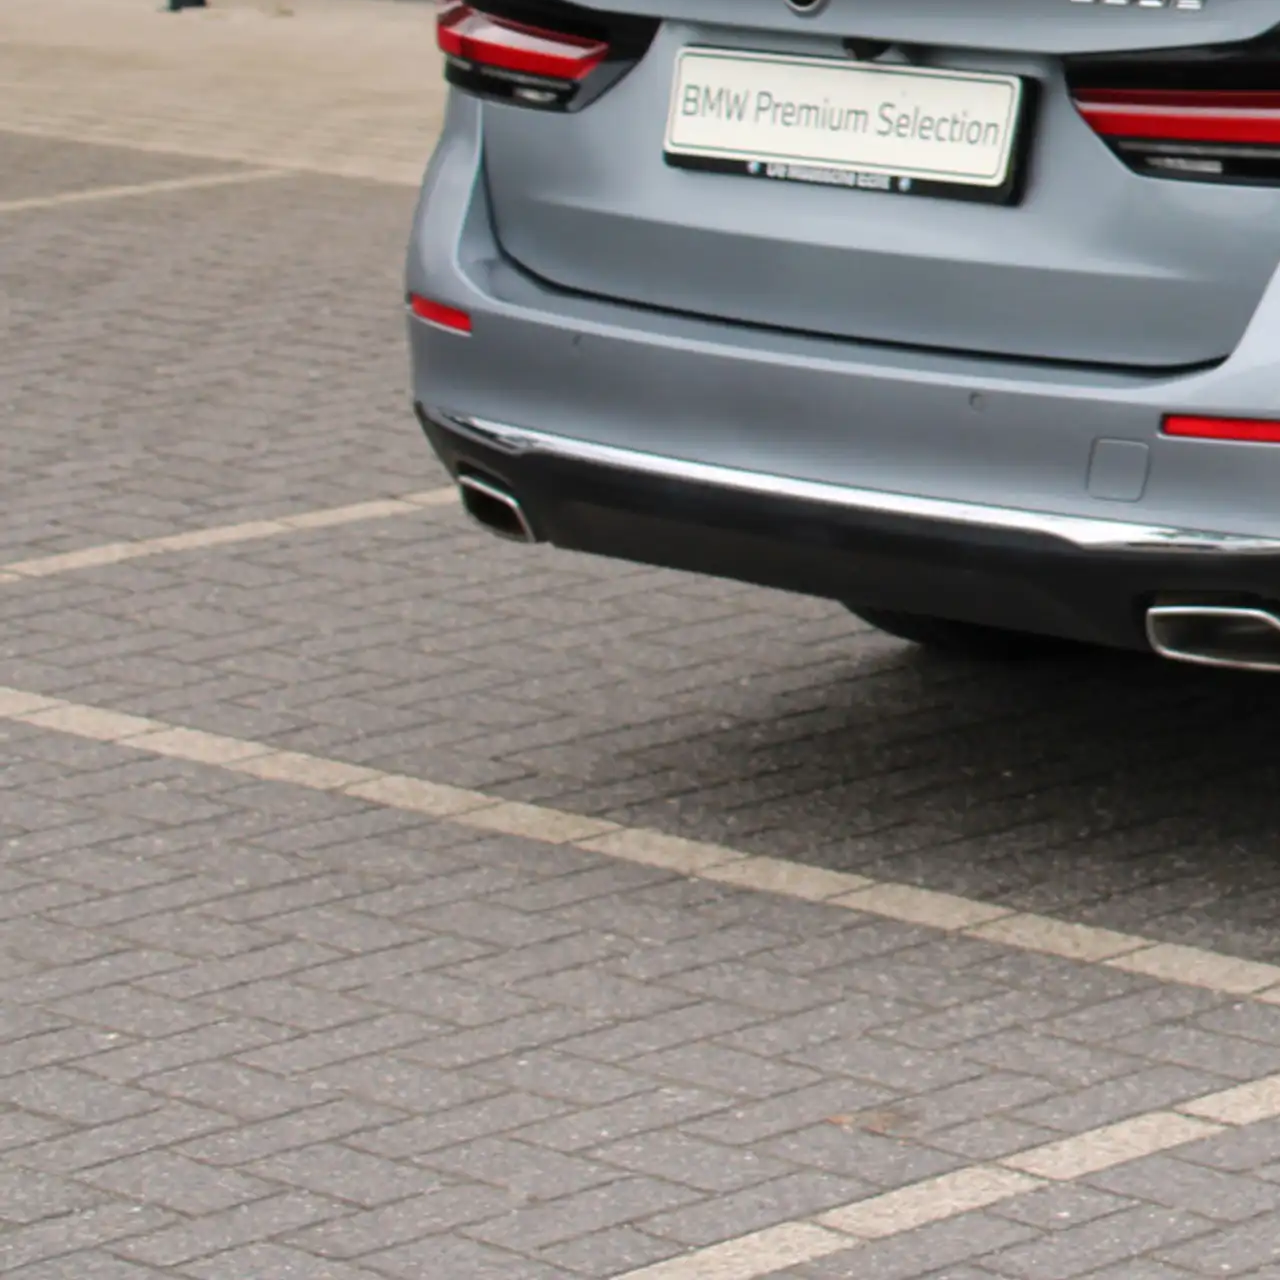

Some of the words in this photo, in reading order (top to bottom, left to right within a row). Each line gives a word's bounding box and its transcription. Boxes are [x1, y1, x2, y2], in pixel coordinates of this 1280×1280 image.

[682, 84, 750, 121] BMW
[755, 90, 869, 133] Premium
[876, 102, 1001, 146] Selection
